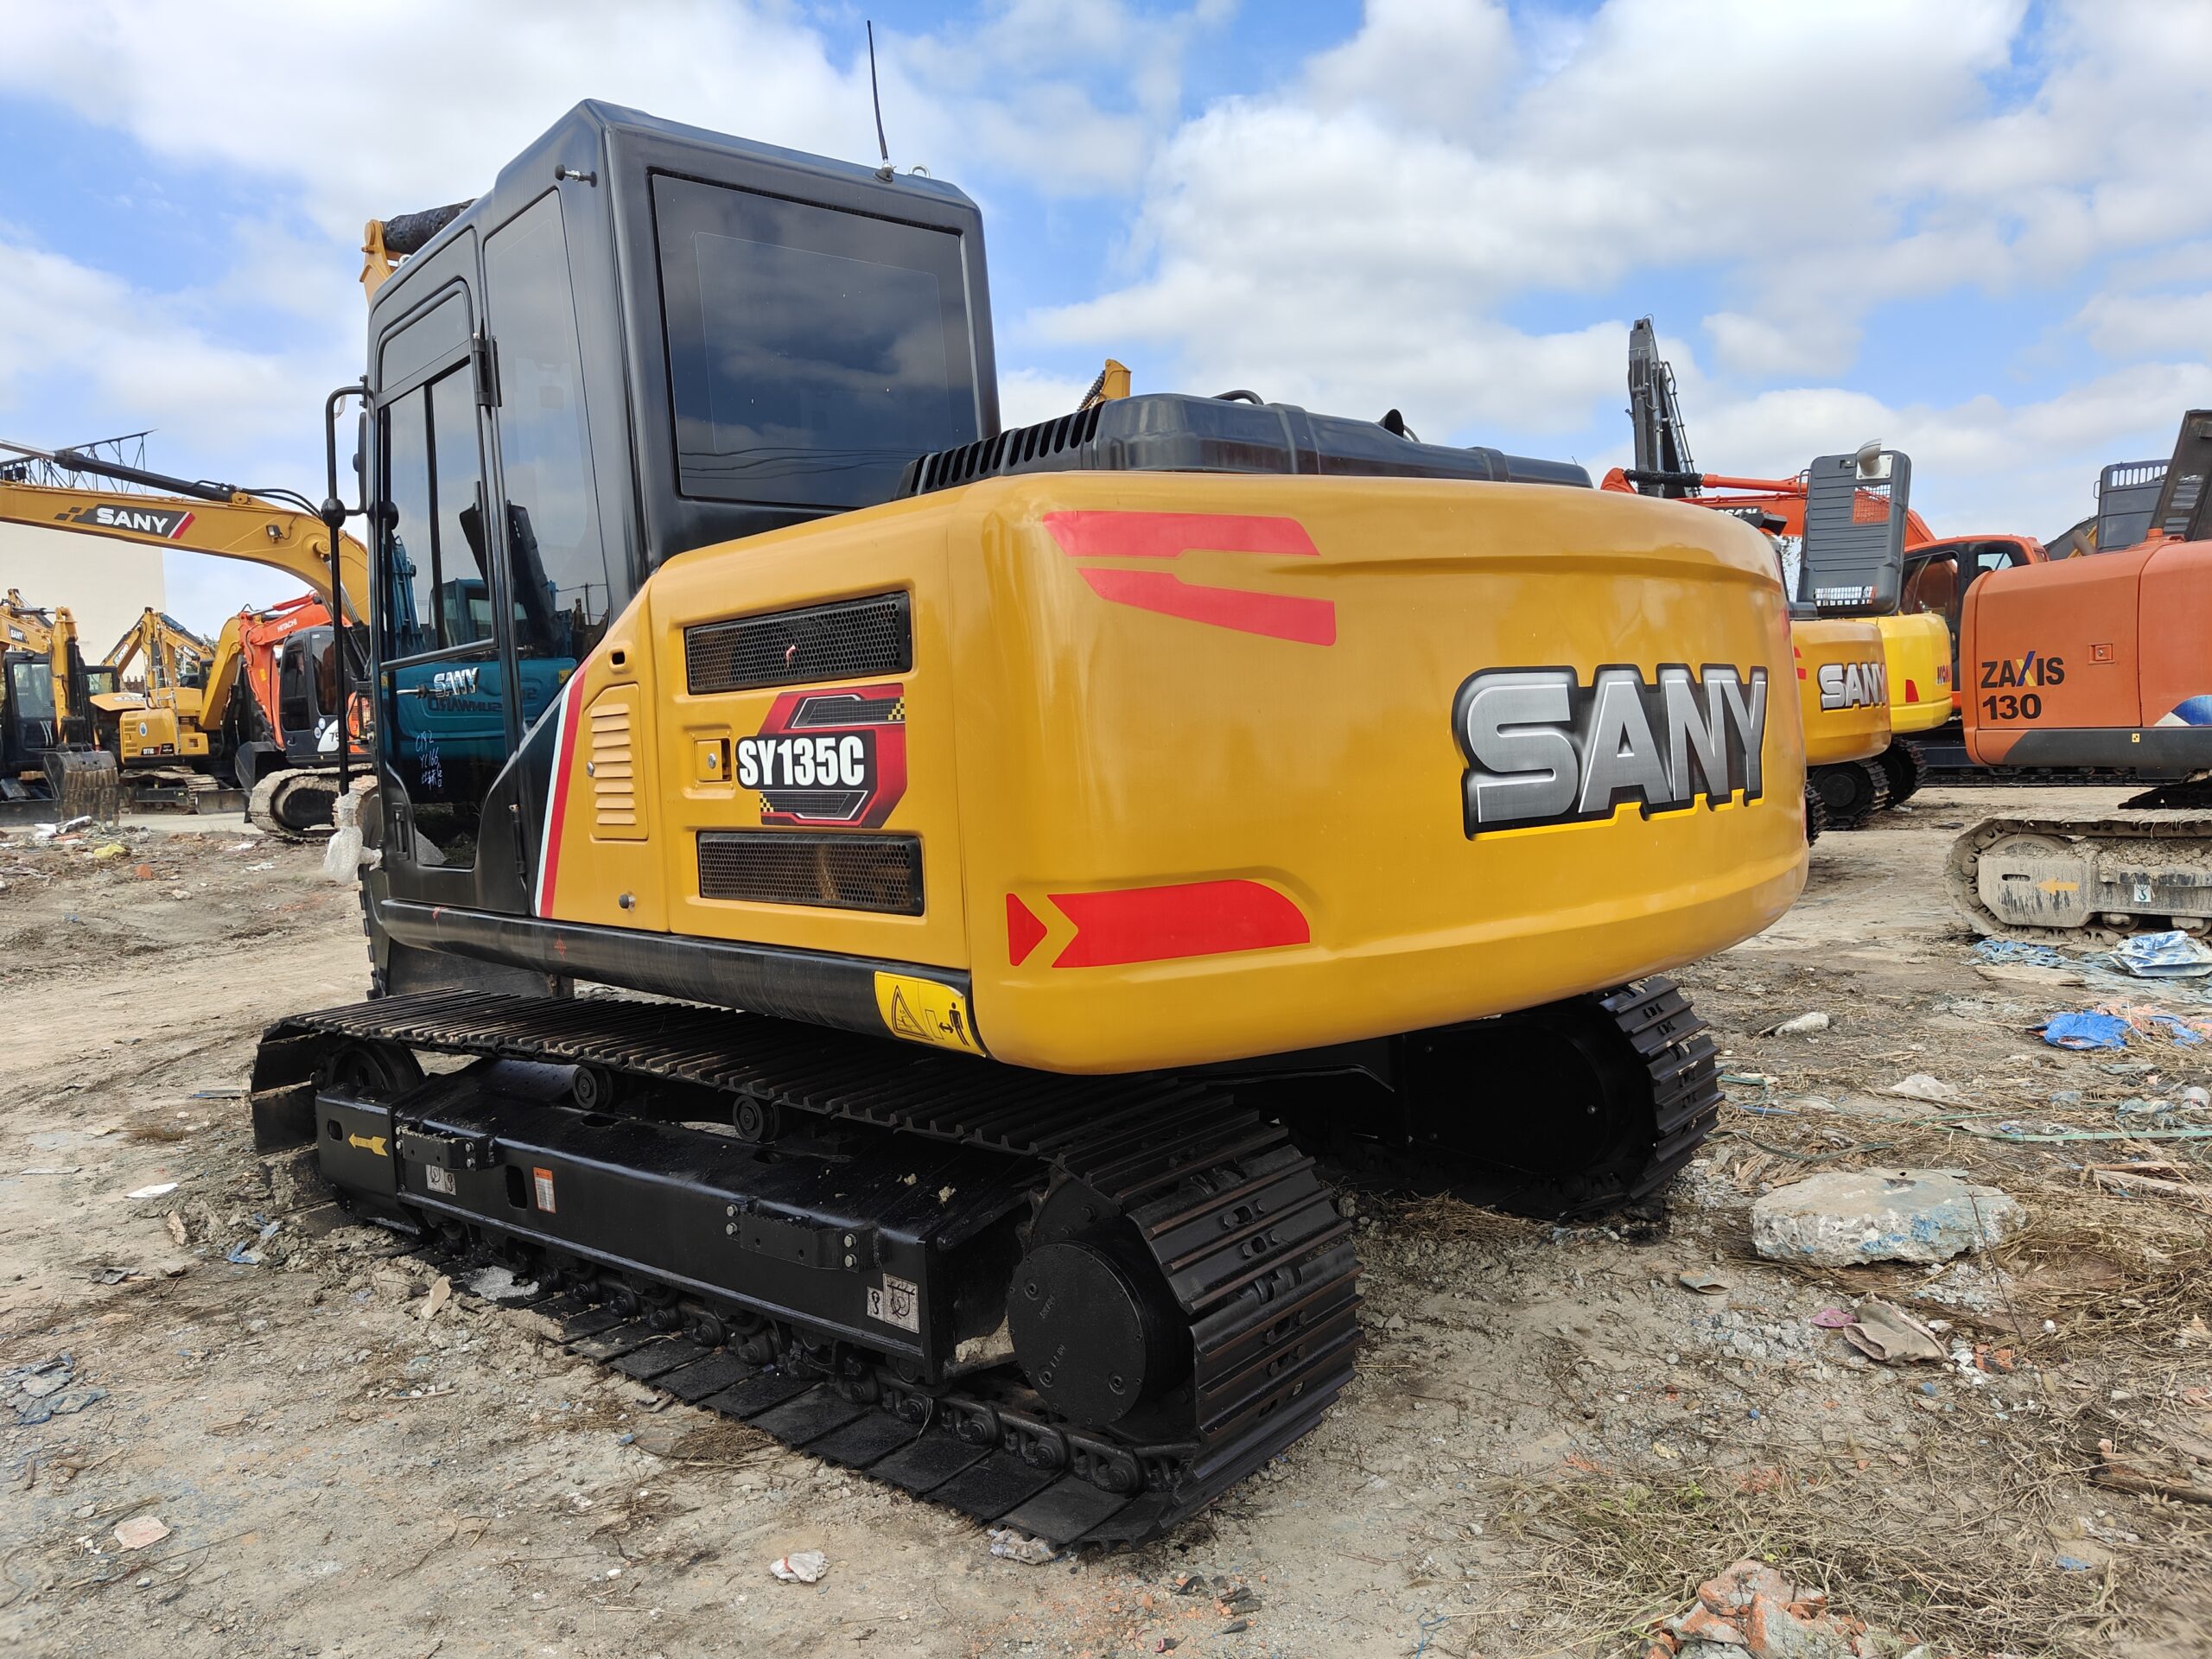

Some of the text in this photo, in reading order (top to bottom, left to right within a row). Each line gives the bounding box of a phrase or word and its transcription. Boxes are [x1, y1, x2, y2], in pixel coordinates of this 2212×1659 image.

[97, 507, 168, 533] SANY
[276, 619, 298, 632] HITACHI
[434, 667, 480, 698] SANY
[1980, 651, 2065, 689] ZAXIS
[1983, 694, 2042, 720] 130
[738, 734, 865, 786] SY135C
[1455, 665, 1768, 838] SANY
